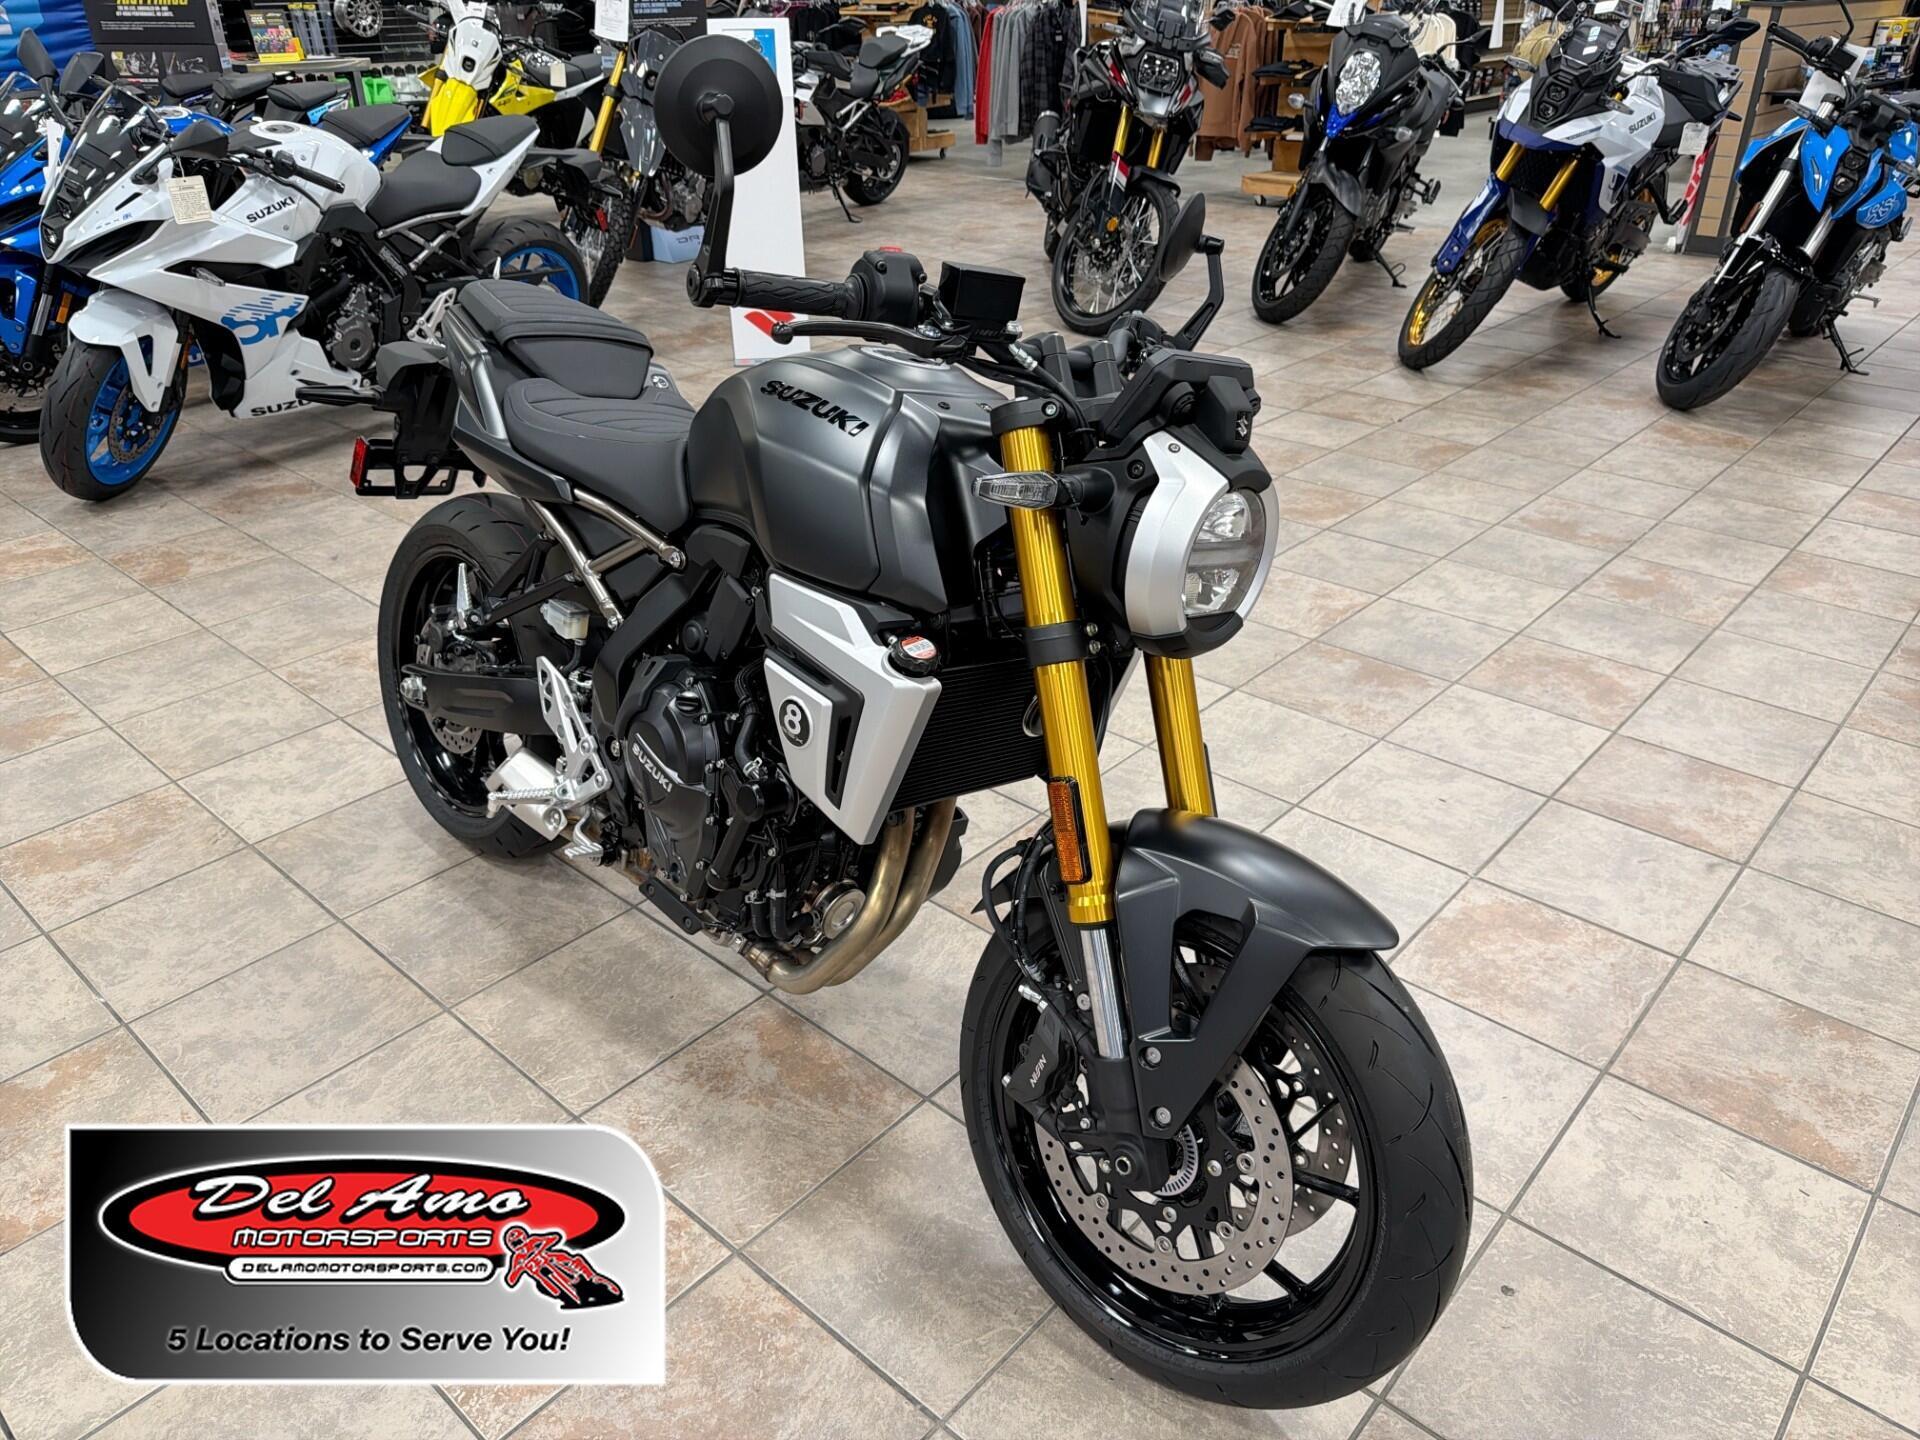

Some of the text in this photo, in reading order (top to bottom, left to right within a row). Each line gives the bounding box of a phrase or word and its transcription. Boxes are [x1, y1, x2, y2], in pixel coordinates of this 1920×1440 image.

[1628, 112, 1657, 134] SUZUKI
[246, 196, 295, 223] SUZUKI
[760, 380, 870, 437] SUZUKI
[783, 703, 802, 735] 8
[632, 742, 673, 793] SUZUKI
